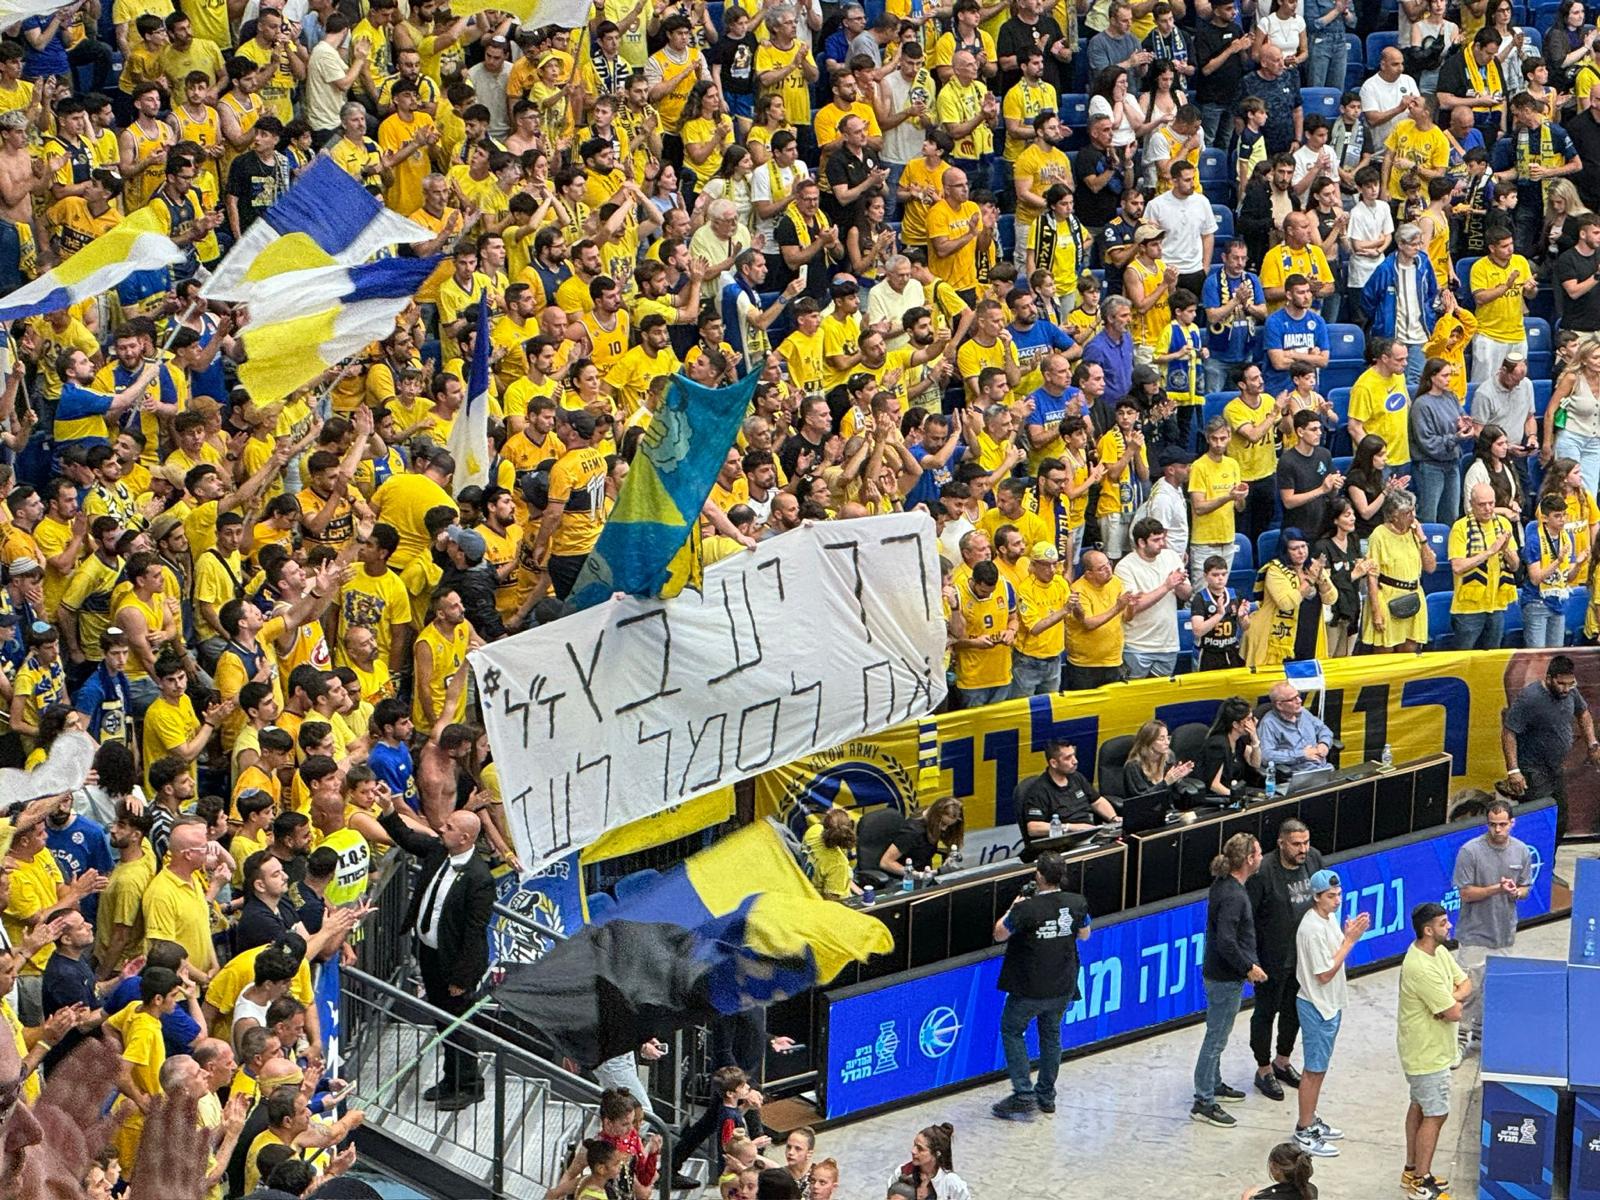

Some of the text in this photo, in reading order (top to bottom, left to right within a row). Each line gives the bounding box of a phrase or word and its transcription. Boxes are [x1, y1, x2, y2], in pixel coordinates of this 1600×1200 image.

[198, 134, 206, 144] 5
[608, 341, 621, 355] 10
[1058, 514, 1069, 530] TEL
[983, 614, 994, 629] 9
[1215, 621, 1232, 637] 50
[638, 671, 822, 801] לסמל
[849, 743, 880, 759] ARMY
[1333, 877, 1404, 942] גבי
[1065, 955, 1122, 1025] מג
[841, 1065, 872, 1084] מגדל
